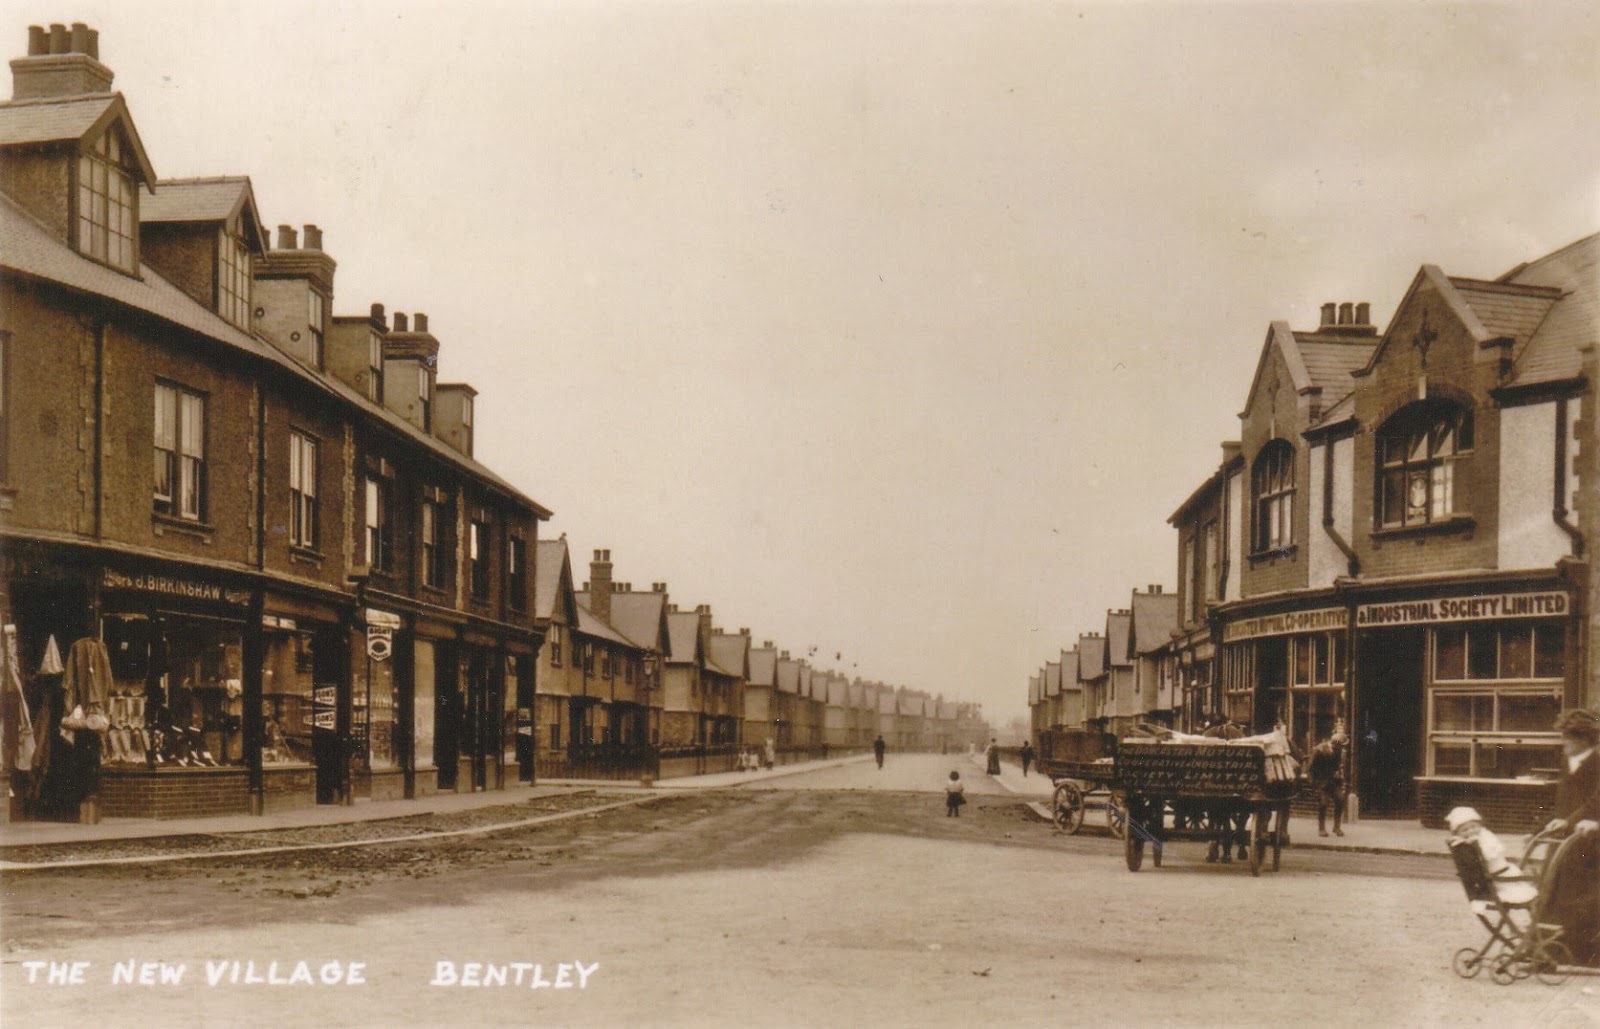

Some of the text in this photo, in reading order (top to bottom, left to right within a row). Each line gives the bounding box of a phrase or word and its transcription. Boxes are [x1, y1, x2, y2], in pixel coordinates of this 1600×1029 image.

[1367, 602, 1437, 623] INDUSTRIAL
[1439, 598, 1500, 617] SOCIETY
[1501, 594, 1565, 615] LIMITED
[1184, 770, 1258, 781] LIMITED
